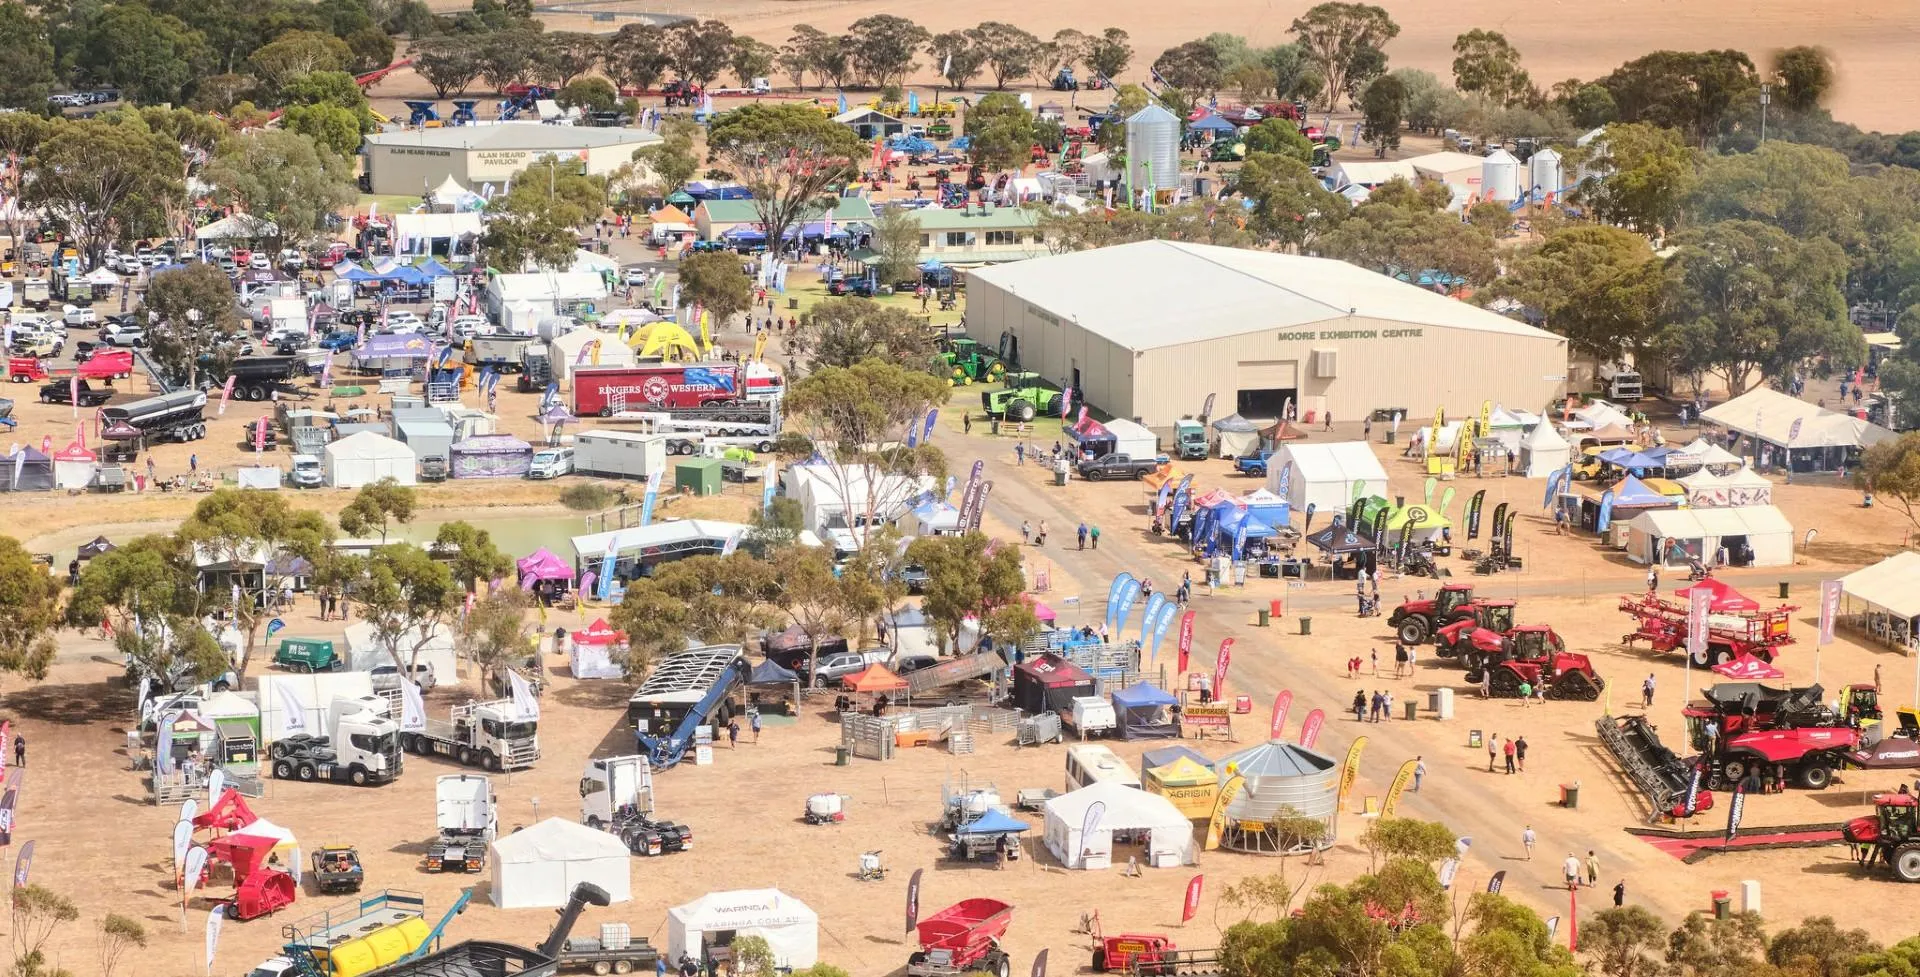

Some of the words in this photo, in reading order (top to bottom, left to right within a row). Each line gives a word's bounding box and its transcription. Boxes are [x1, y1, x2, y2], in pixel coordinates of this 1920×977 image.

[499, 151, 526, 159] HEARD
[484, 158, 518, 166] PAVILION
[1277, 332, 1316, 341] MOORE
[1319, 330, 1377, 340] EXHIBITION
[1381, 329, 1423, 338] CENTRE
[598, 385, 641, 395] RINGERS
[670, 383, 717, 393] WESTERN
[1878, 750, 1919, 760] O'CONNORS
[1170, 789, 1211, 798] AGRIBIN
[714, 904, 770, 913] WARINGA
